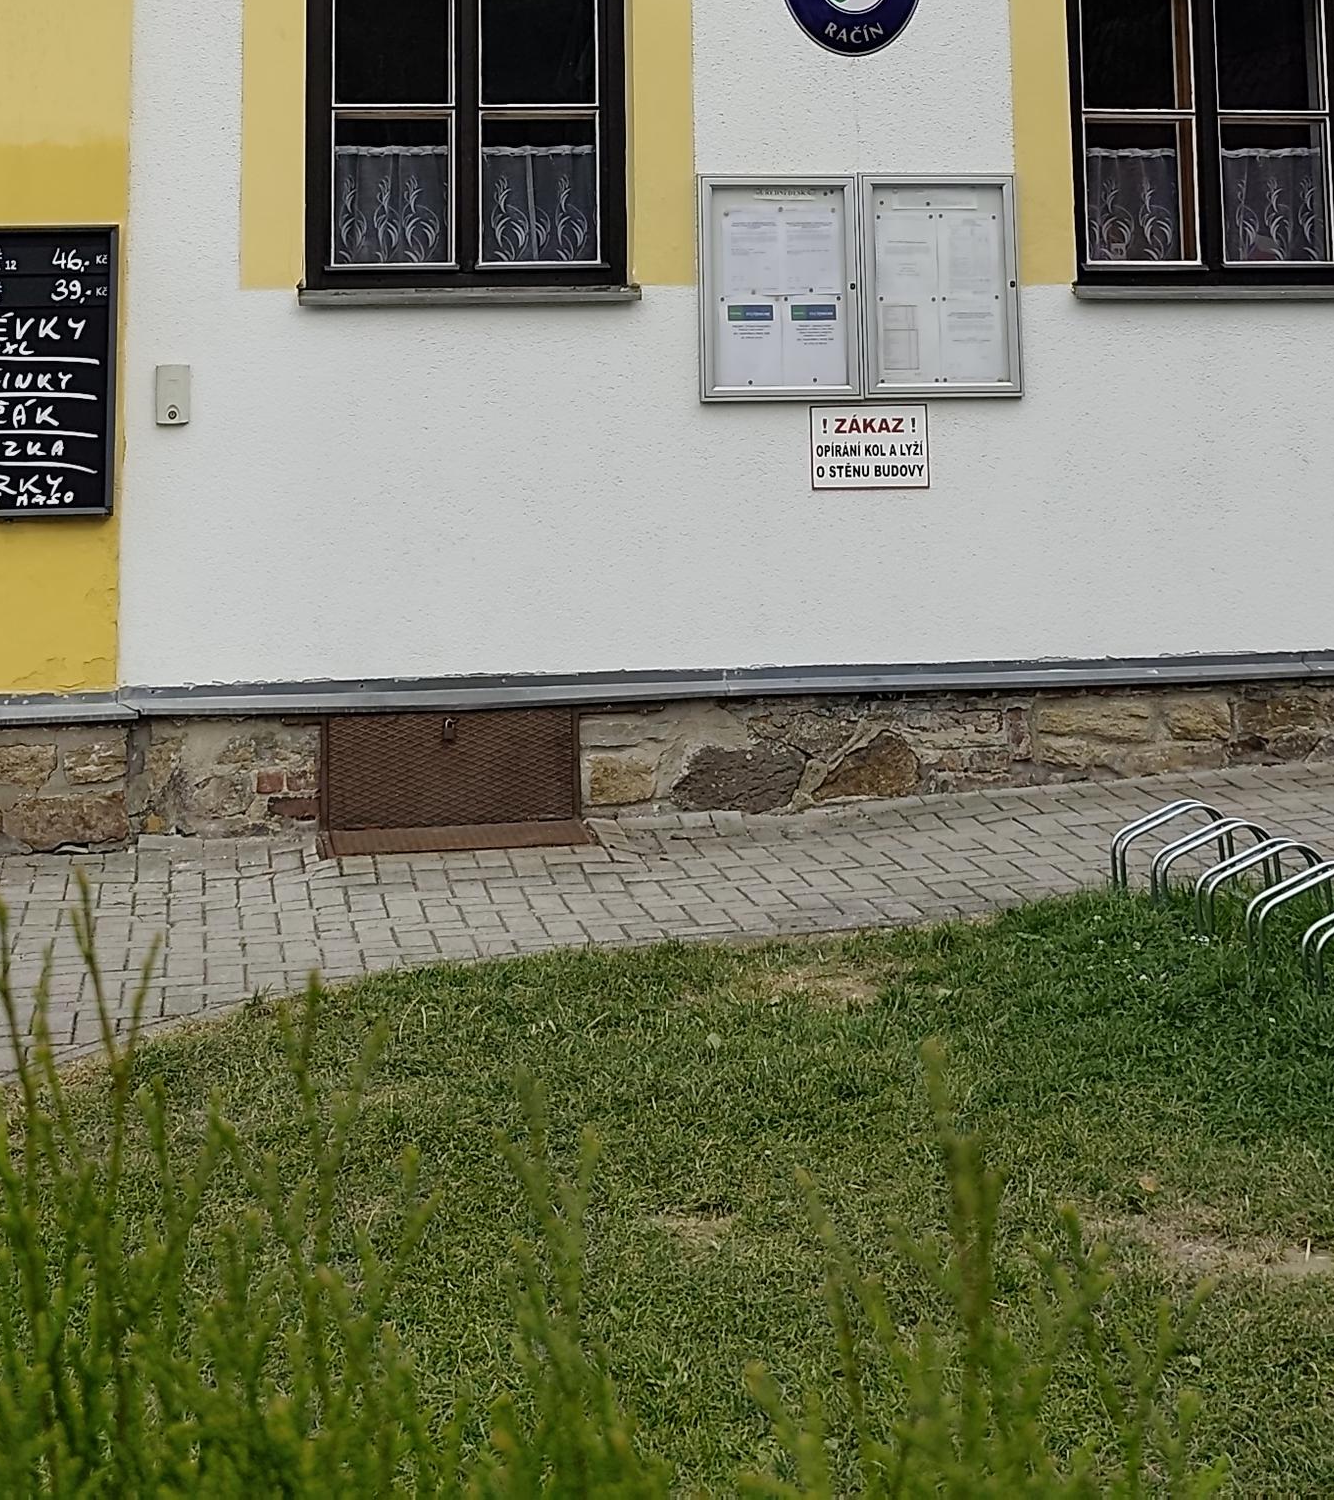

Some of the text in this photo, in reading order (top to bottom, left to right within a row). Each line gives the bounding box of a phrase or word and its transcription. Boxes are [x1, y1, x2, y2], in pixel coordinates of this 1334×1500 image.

[824, 21, 885, 44] RAČÍN
[5, 260, 17, 270] 12
[51, 247, 108, 272] 46,- Kč
[51, 279, 108, 304] 39,- Kč
[834, 414, 905, 434] ZÁKAZ
[816, 440, 924, 458] OPÍRÁNÍ KOL A LYŽÍ
[816, 462, 925, 478] O STĚNU BUDOVY
[15, 490, 75, 507] MASO
